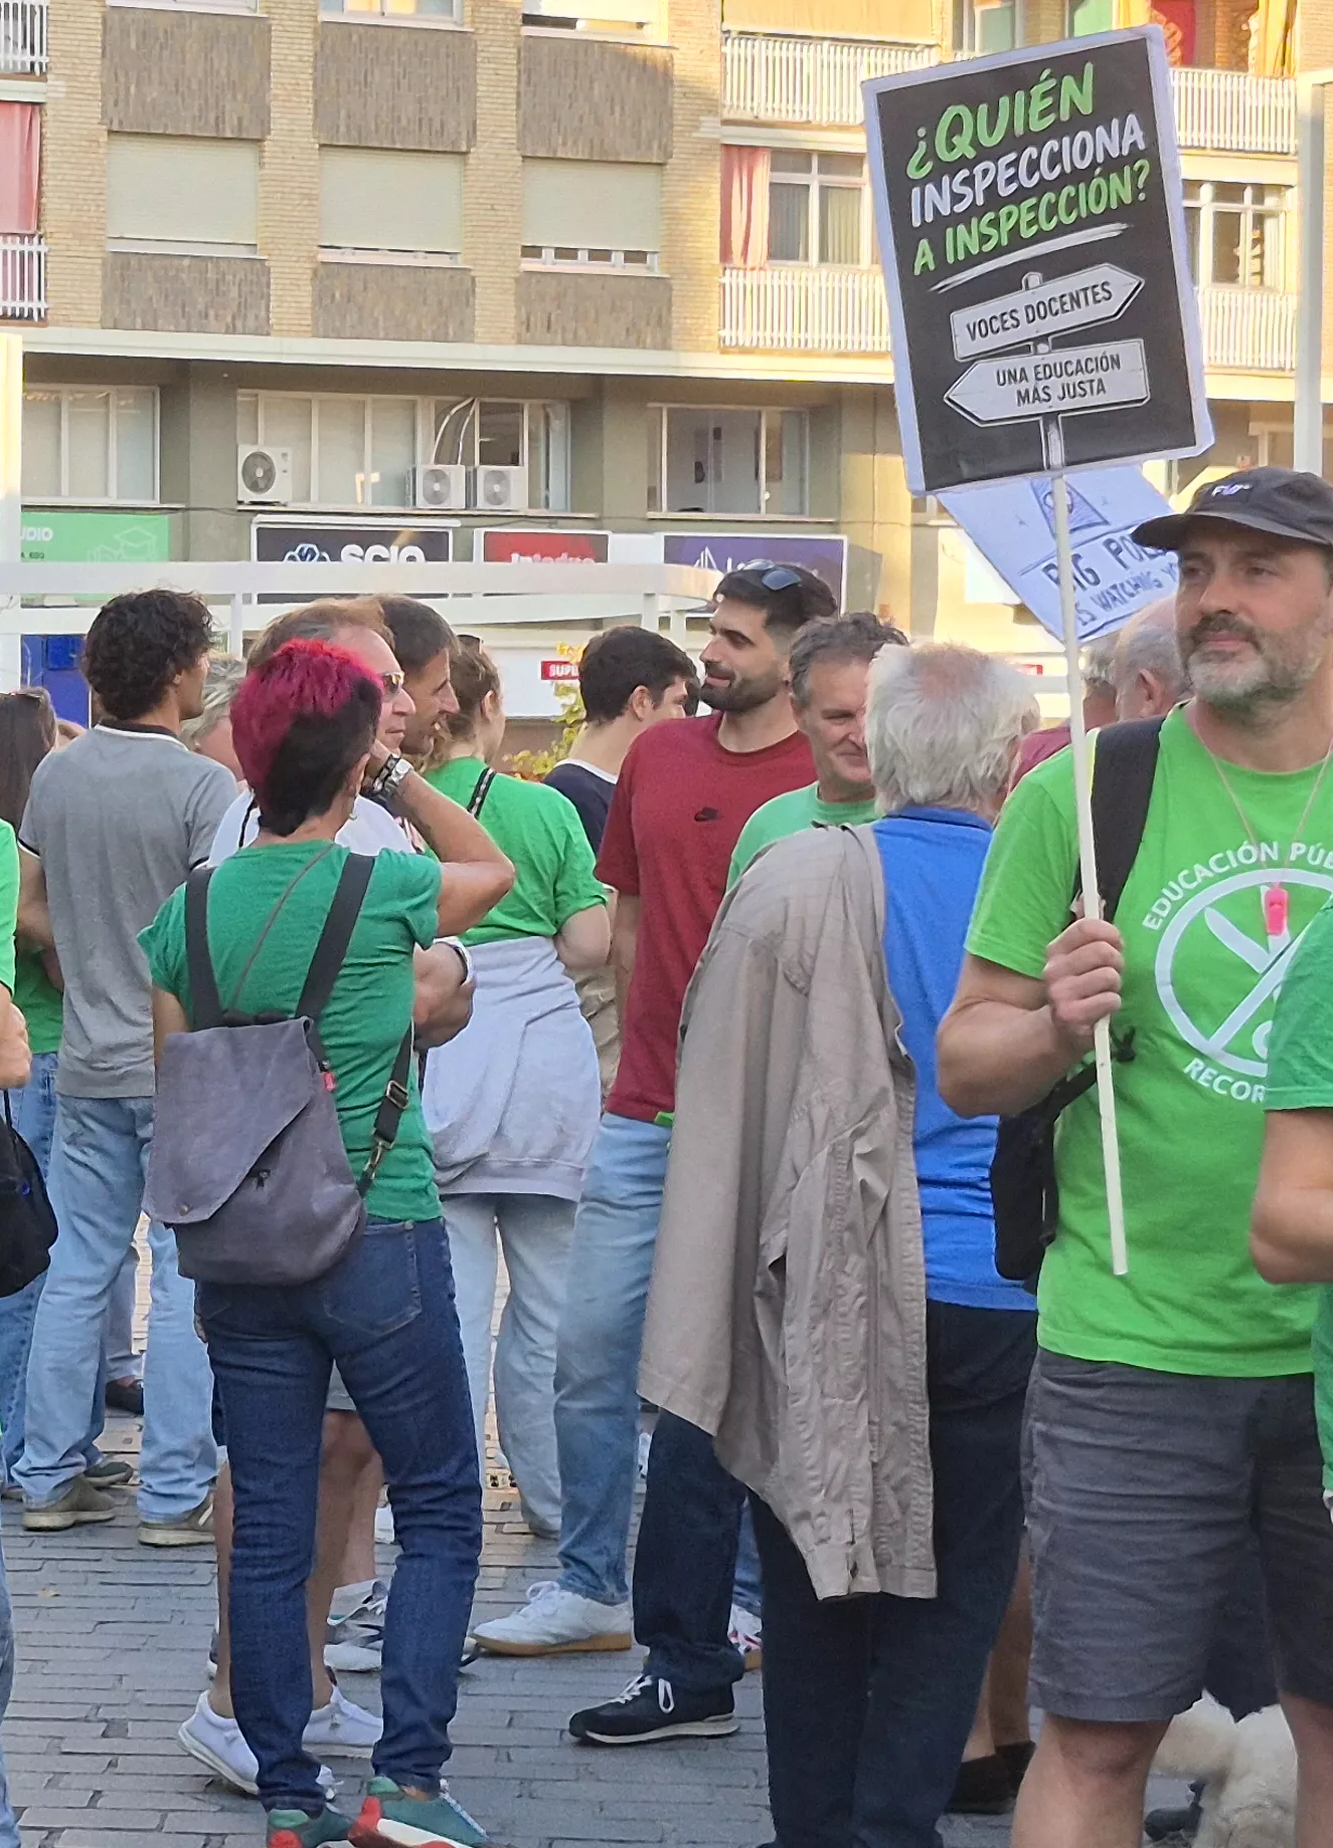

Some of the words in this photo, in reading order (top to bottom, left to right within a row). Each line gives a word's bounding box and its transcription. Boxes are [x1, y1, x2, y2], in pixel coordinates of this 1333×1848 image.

[906, 61, 1093, 180] ¿QUIÉN
[911, 113, 1146, 228] INSPECCIONA
[913, 238, 936, 276] A
[945, 158, 1150, 264] INSPECCIÓN?
[966, 309, 1021, 342] VOCES
[1024, 280, 1113, 324] DOCENTES
[996, 367, 1029, 387] UNA
[1034, 351, 1121, 381] EDUCACIÓN
[1016, 384, 1052, 407] MÁS
[1057, 378, 1107, 402] JUSTA
[1142, 841, 1278, 930] EDUCACIÓN
[1183, 1057, 1267, 1104] RECOR
